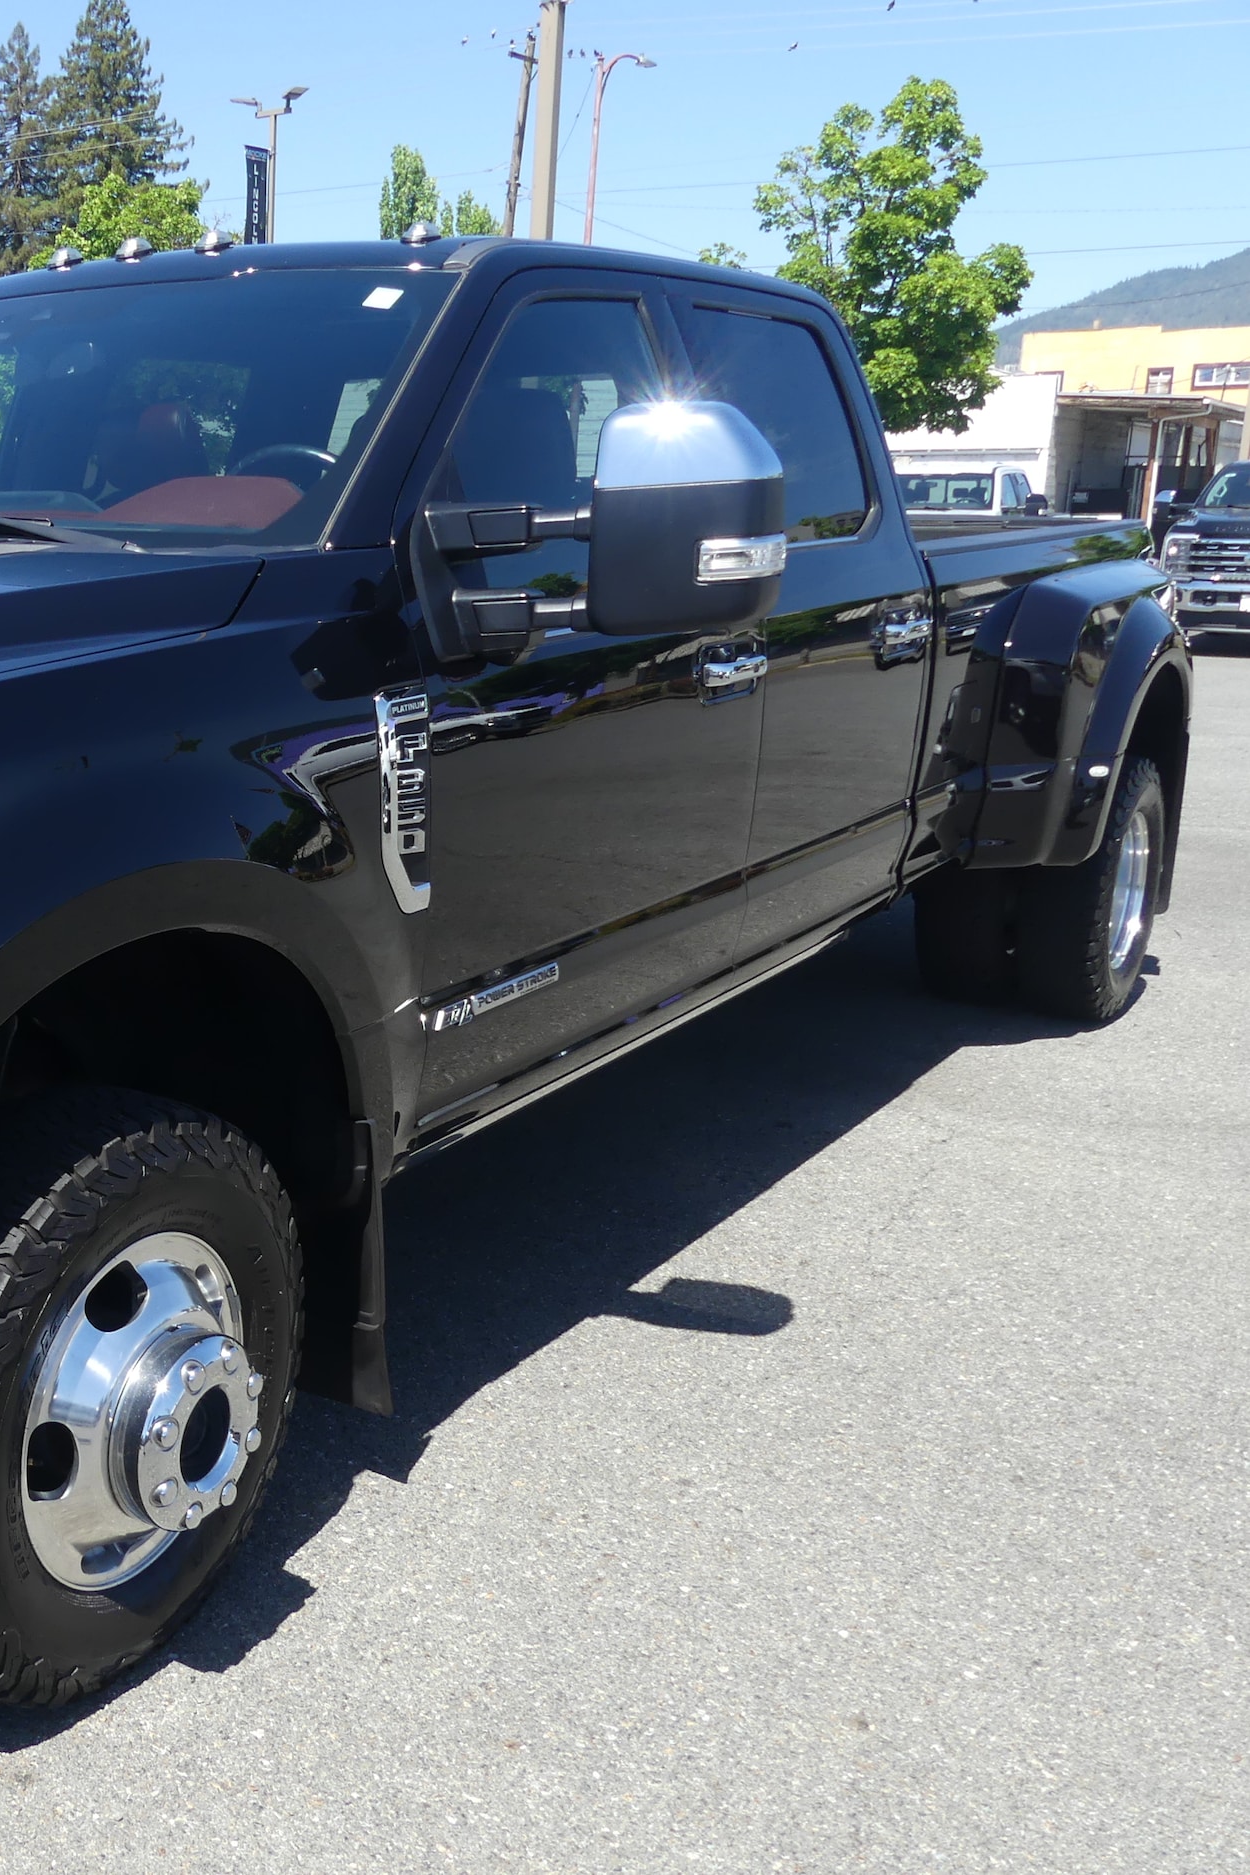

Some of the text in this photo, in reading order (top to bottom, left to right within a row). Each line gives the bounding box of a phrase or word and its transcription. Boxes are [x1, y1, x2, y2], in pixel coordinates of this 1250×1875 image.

[391, 700, 425, 715] PLATINUM
[478, 984, 515, 1008] POWER
[516, 966, 557, 990] STROKE
